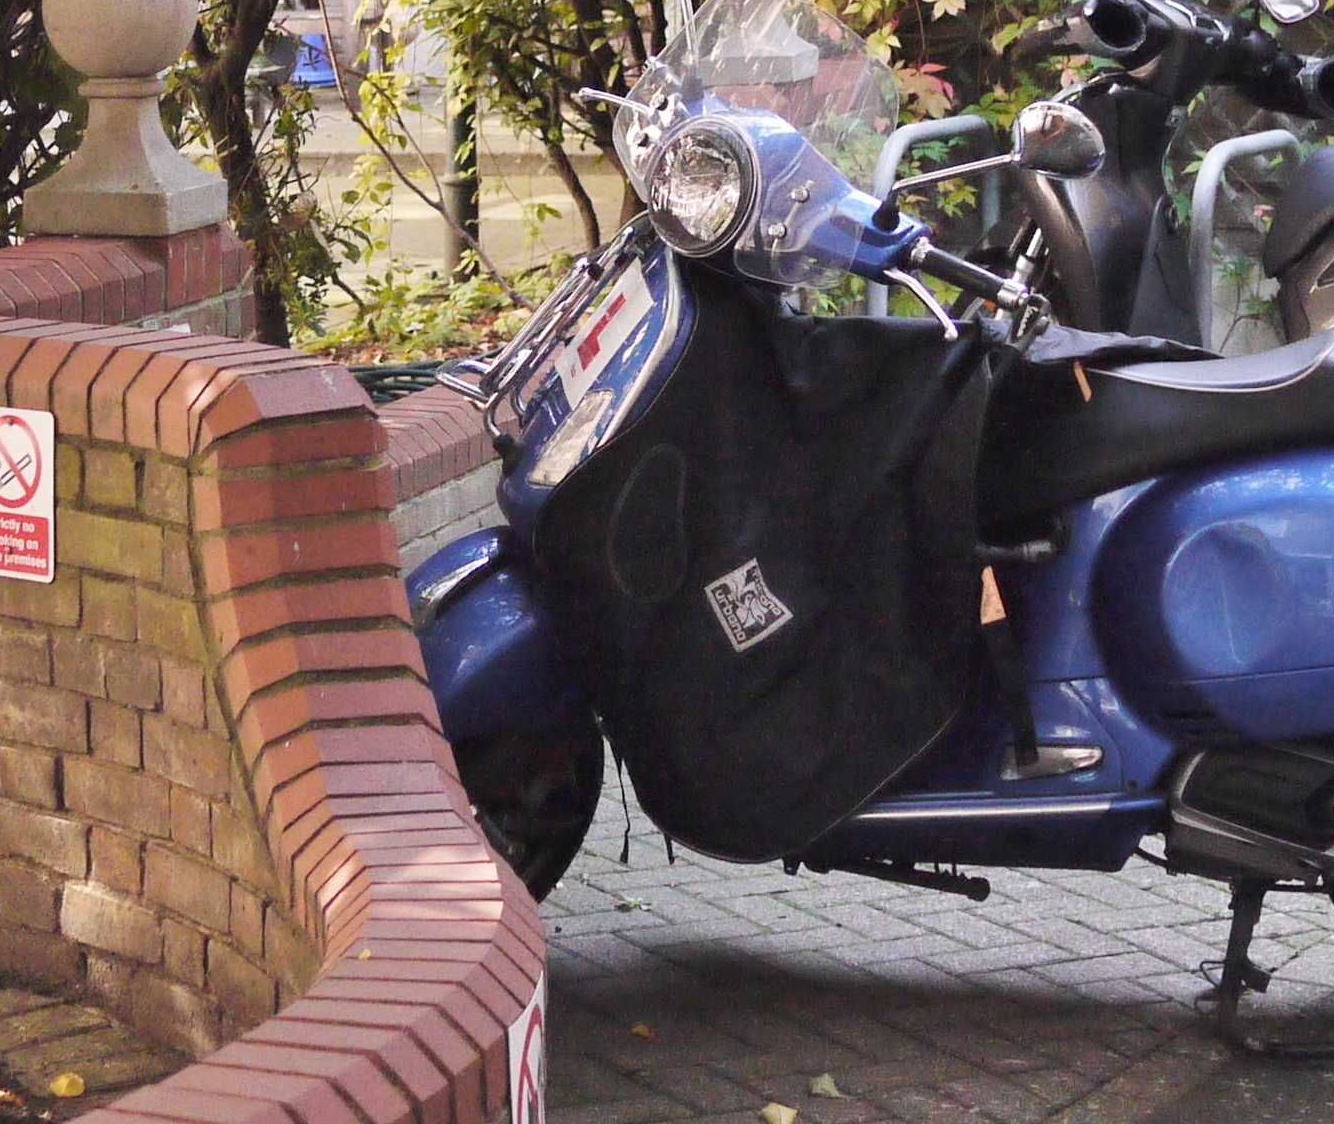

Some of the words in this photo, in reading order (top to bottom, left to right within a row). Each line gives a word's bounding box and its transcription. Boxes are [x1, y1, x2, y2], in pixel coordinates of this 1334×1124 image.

[22, 523, 35, 533] no
[26, 540, 39, 551] on
[4, 553, 47, 569] premises
[715, 587, 748, 643] urbano
